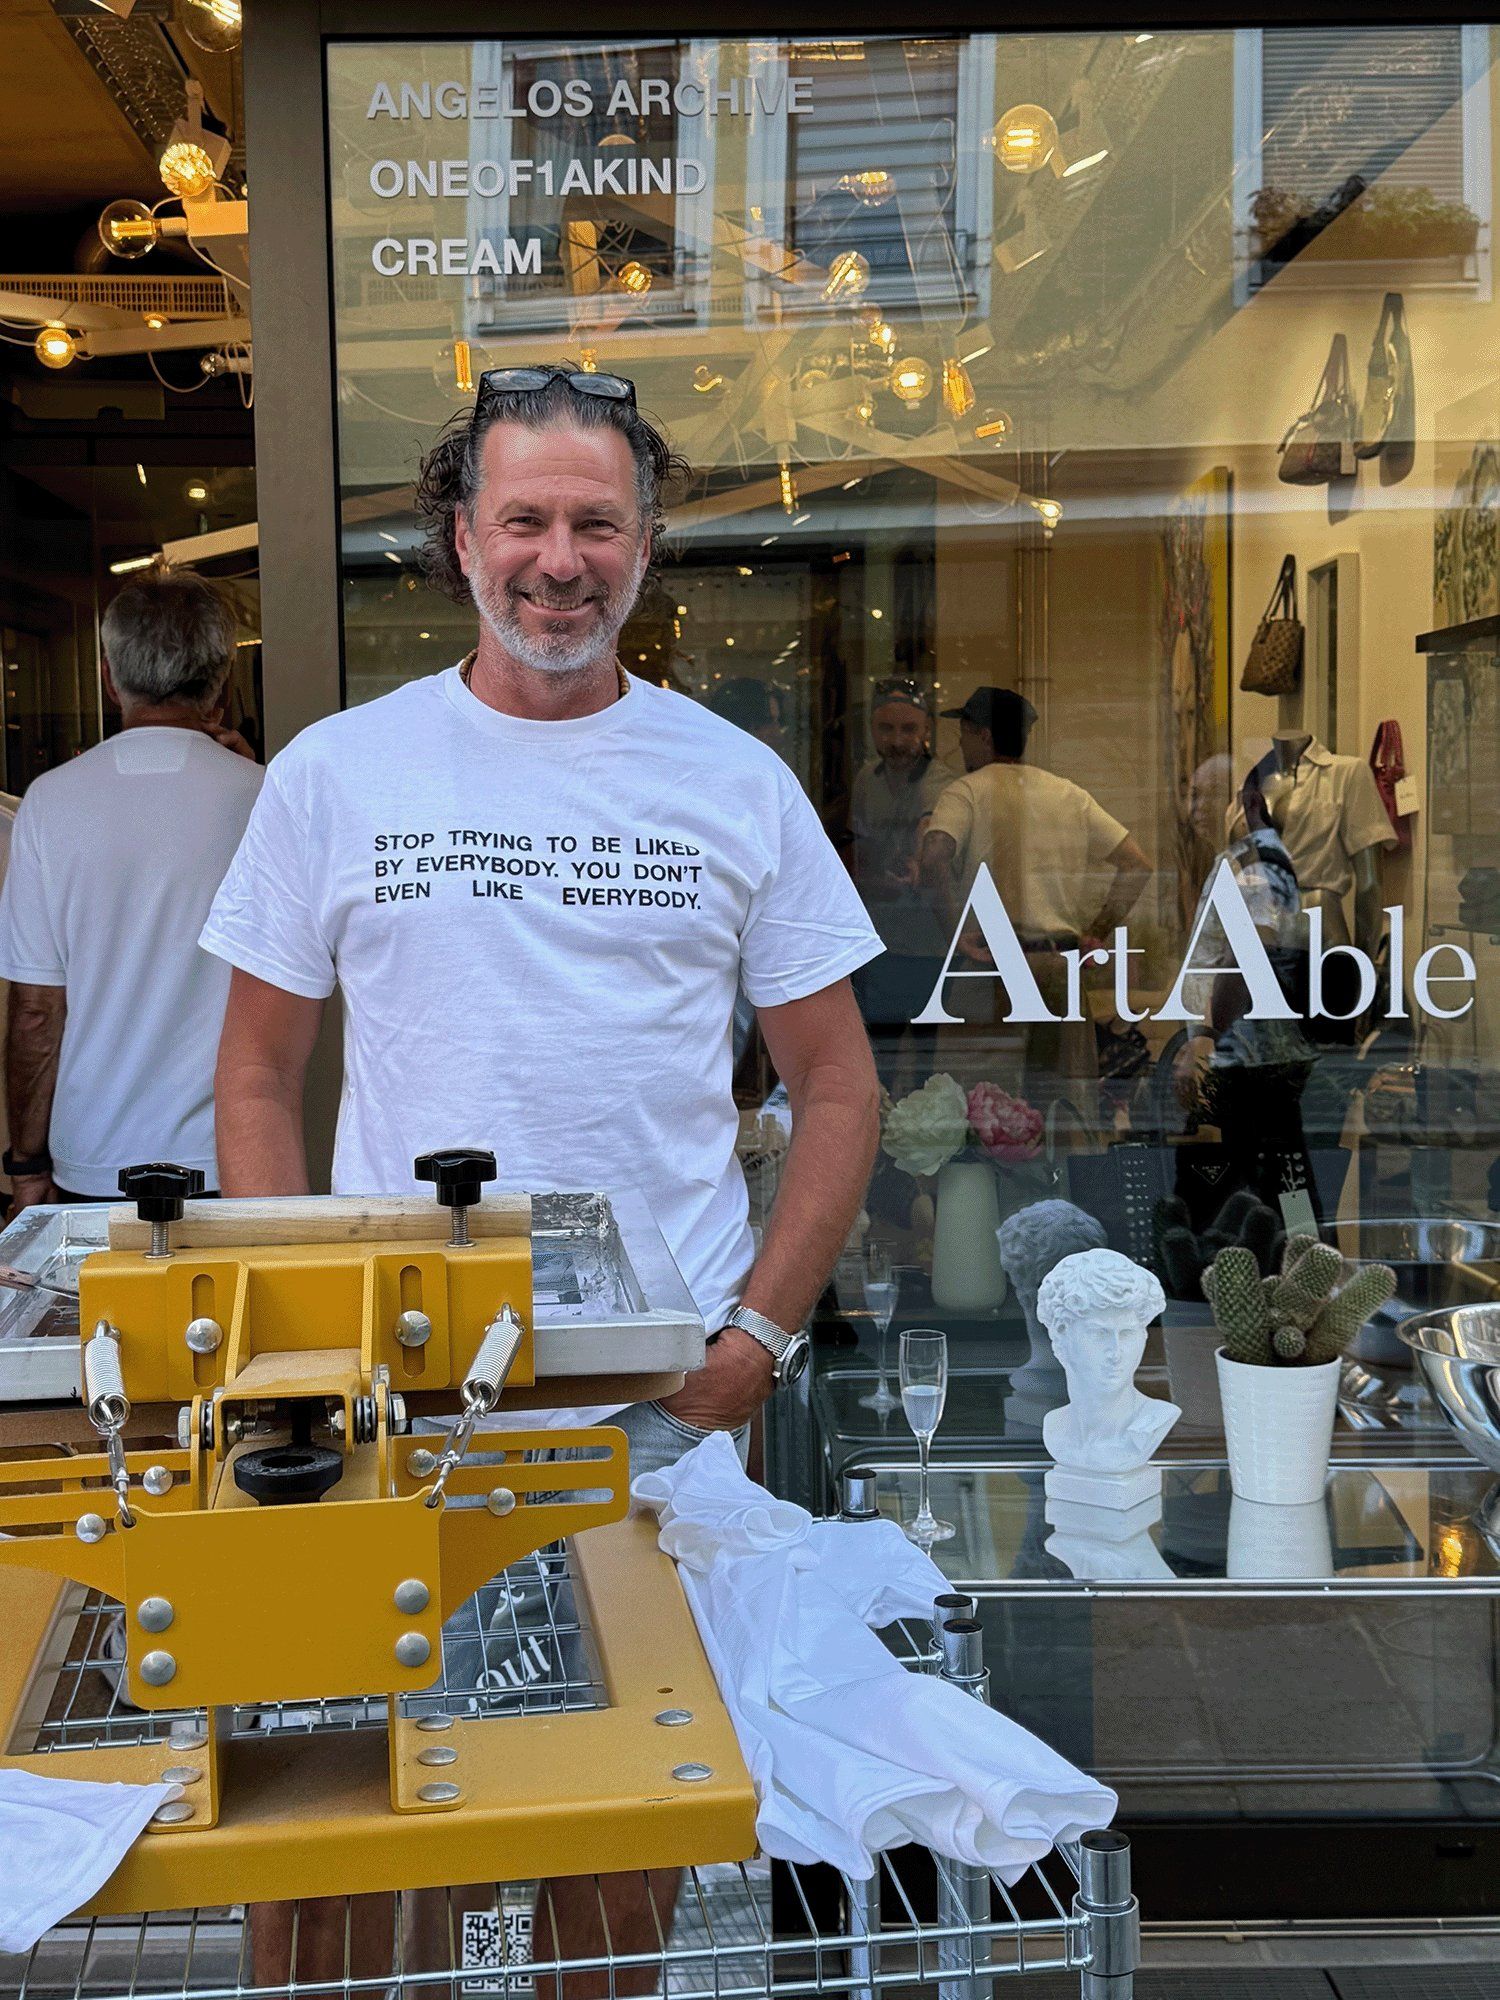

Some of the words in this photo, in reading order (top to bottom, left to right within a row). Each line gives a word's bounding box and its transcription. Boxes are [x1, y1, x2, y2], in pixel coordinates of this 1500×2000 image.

[366, 79, 593, 119] ANGELOS
[606, 77, 815, 117] ARCHIVE
[369, 158, 707, 198] ONEOF1AKIND
[371, 238, 542, 276] CREAM
[374, 833, 435, 852] STOP
[447, 829, 533, 852] TRYING
[546, 835, 577, 854] TO
[591, 836, 622, 854] BE
[635, 837, 700, 857] LIKED
[375, 858, 404, 878] BY
[416, 853, 559, 878] EVERYBODY.
[570, 861, 621, 880] YOU
[633, 863, 703, 884] DON'T
[375, 881, 431, 904] EVEN
[472, 879, 524, 901] LIKE
[562, 887, 701, 910] EVERYBODY.
